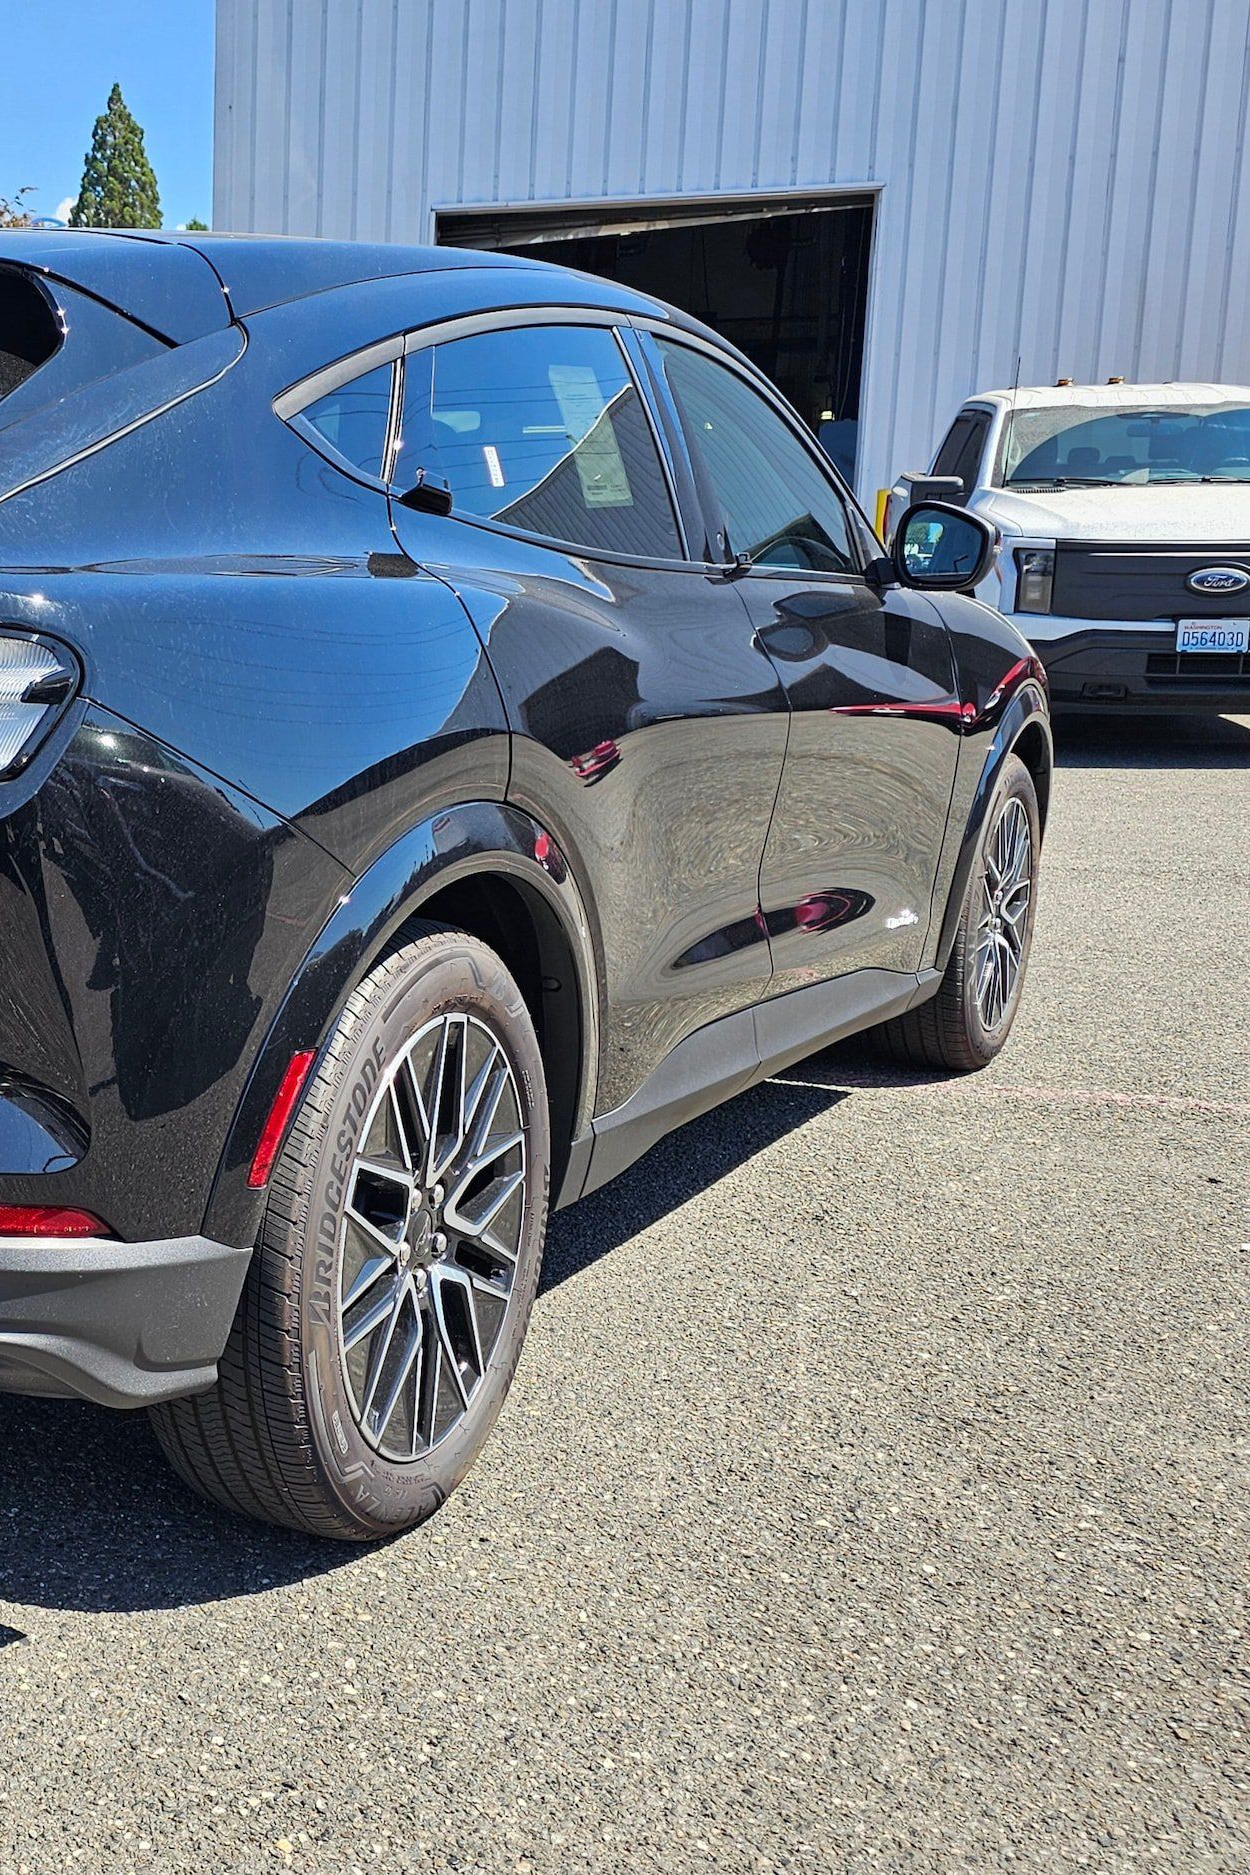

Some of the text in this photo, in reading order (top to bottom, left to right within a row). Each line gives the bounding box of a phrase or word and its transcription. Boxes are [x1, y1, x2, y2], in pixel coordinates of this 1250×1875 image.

[1203, 573, 1236, 588] Ford
[1182, 631, 1244, 647] D56403D
[308, 1036, 386, 1325] BRIDGESTONE
